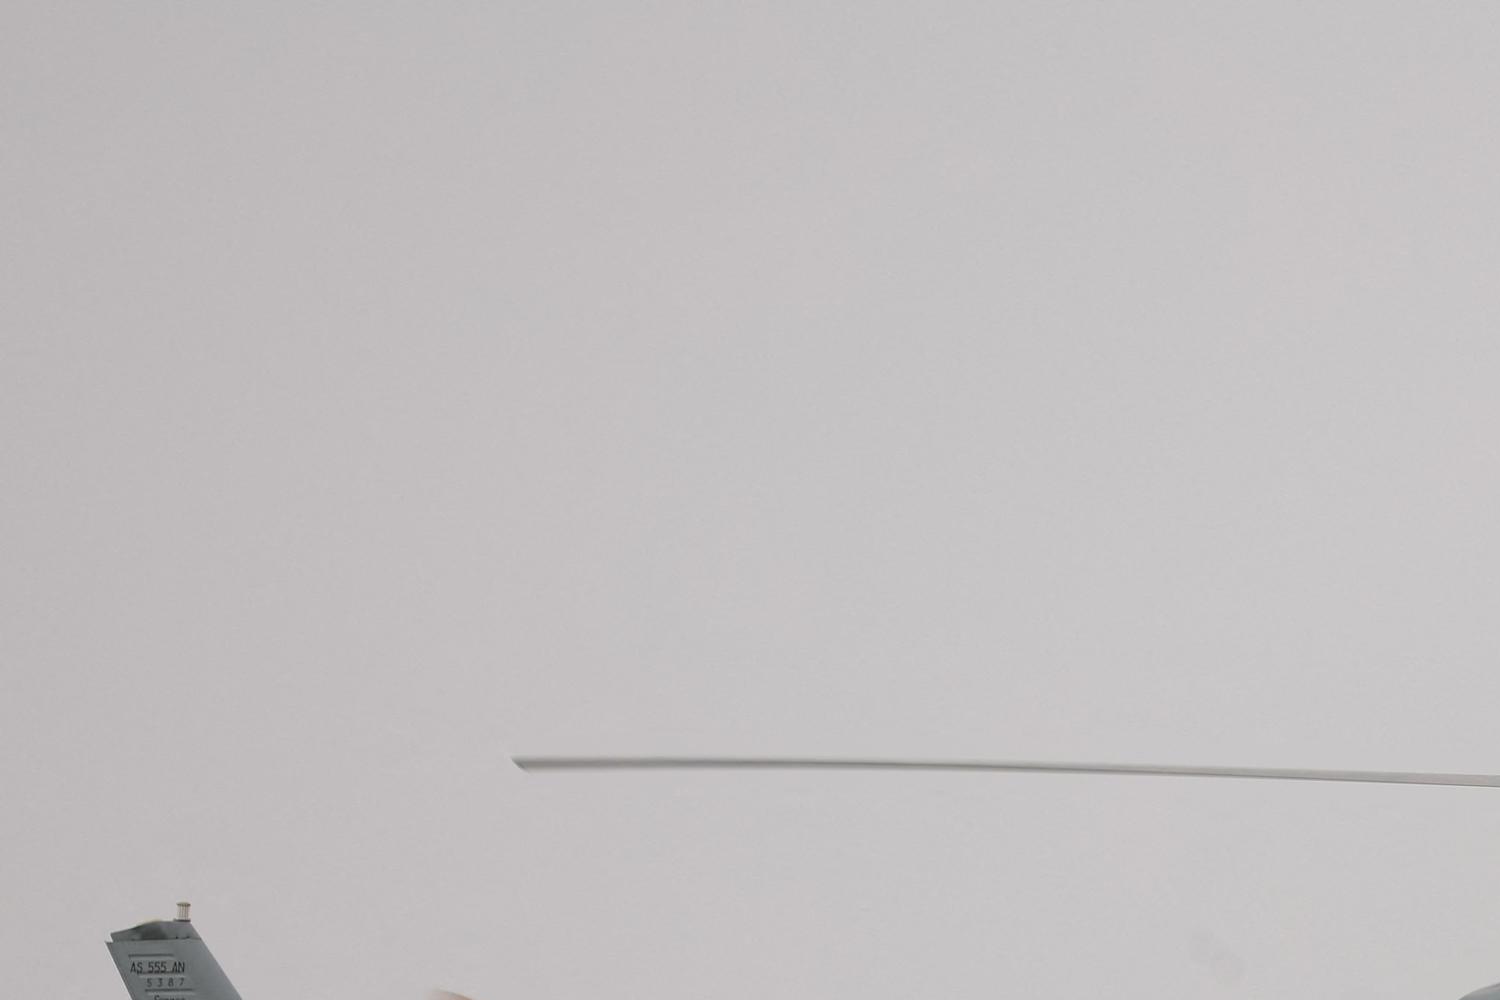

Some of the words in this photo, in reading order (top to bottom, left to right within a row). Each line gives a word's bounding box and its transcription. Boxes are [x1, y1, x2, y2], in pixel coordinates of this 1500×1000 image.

[130, 961, 143, 974] AS
[147, 961, 167, 974] 555
[171, 961, 185, 974] AN
